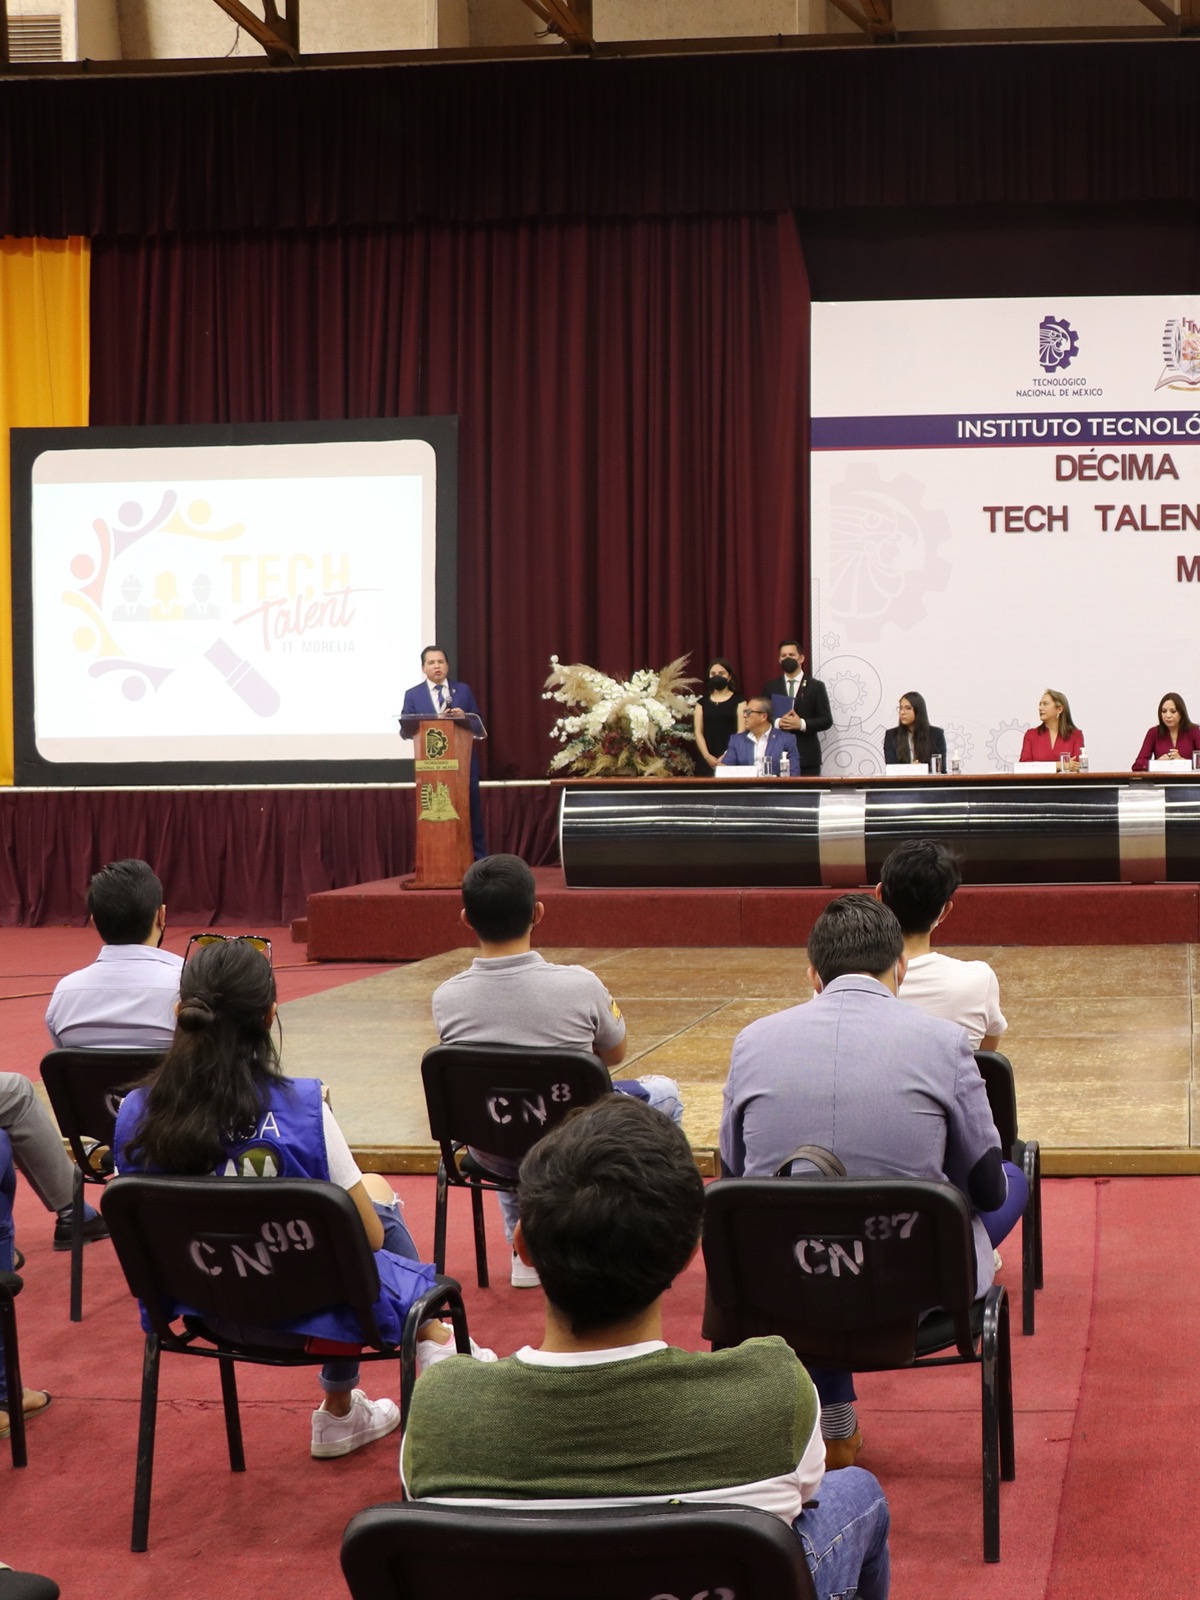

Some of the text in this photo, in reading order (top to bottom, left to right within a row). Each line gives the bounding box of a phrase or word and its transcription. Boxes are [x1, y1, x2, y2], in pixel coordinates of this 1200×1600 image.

[1016, 389, 1056, 397] NACIONAL
[1059, 389, 1069, 397] DE
[957, 418, 1082, 438] INSTITUTO
[1055, 447, 1180, 481] DÉCIMA
[982, 504, 1069, 533] TECH
[222, 553, 351, 604] TECH
[233, 586, 386, 651] Talent
[302, 640, 356, 653] MORELIA
[551, 1083, 571, 1102] 8
[261, 1219, 315, 1253] 99
[864, 1211, 919, 1240] 87
